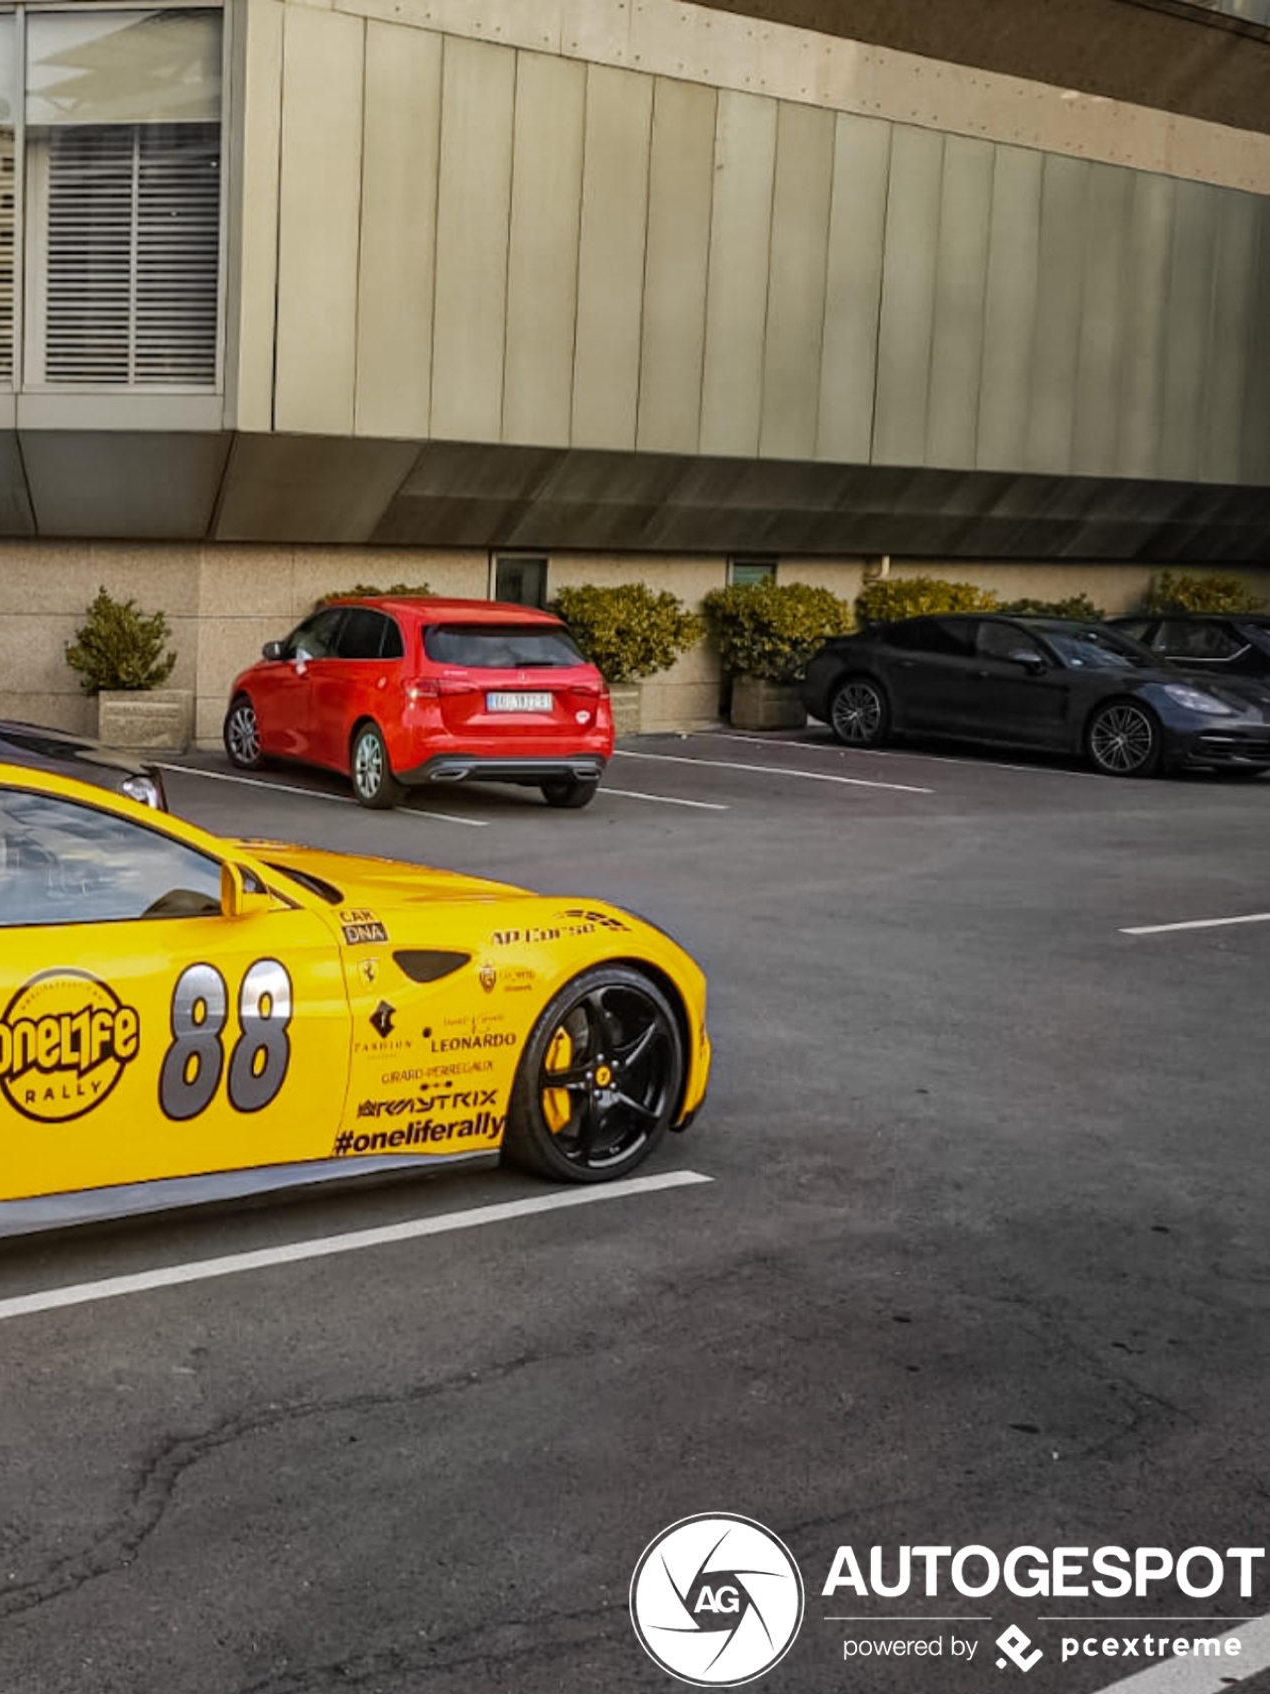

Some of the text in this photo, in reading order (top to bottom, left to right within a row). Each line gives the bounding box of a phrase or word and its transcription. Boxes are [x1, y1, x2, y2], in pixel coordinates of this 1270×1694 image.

[345, 924, 385, 943] DNA
[157, 956, 294, 1122] 88
[430, 1033, 517, 1053] LEONARDO
[25, 1081, 101, 1104] RALLY
[333, 1111, 507, 1156] #oneliferally
